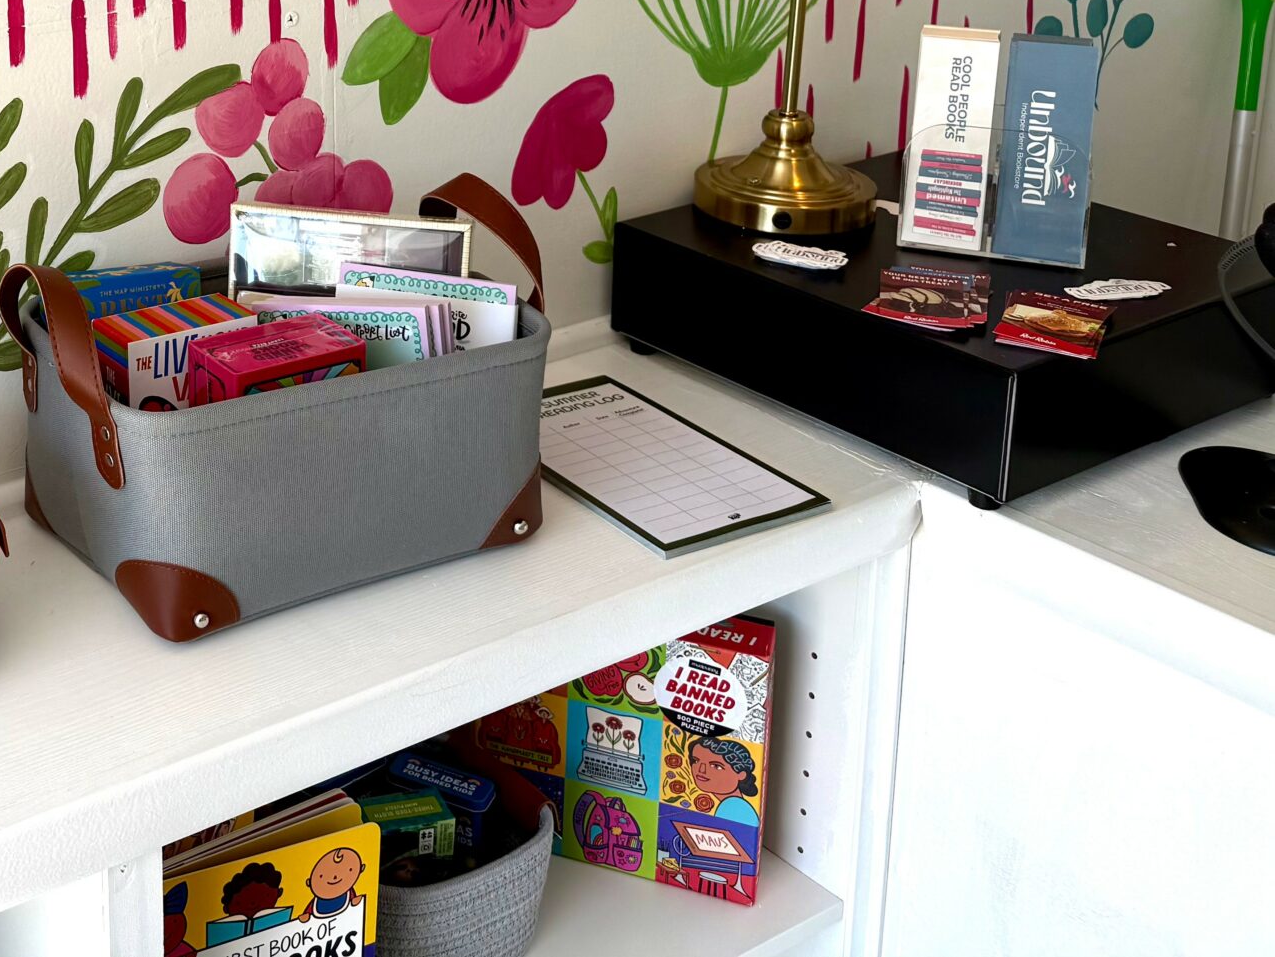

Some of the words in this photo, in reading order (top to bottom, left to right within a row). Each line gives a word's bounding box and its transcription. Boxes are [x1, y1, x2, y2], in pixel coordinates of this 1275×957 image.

[949, 57, 962, 92] READ
[960, 56, 972, 91] COOL
[944, 95, 958, 140] BOOKS
[955, 93, 969, 143] PEOPLE
[1021, 90, 1056, 205] Unbound
[1014, 152, 1023, 189] Bookstore
[926, 193, 967, 204] Untamed
[883, 270, 906, 278] YOUR
[1035, 291, 1058, 301] GET
[1073, 300, 1108, 310] FREE
[1035, 336, 1057, 346] Robin
[136, 356, 153, 372] THE
[540, 390, 601, 409] SUMMER
[597, 393, 625, 407] LOG
[749, 637, 757, 646] I
[587, 666, 616, 689] GIVING
[675, 667, 684, 679] I
[686, 670, 731, 693] READ
[665, 679, 735, 709] BANNED
[670, 696, 726, 723] BOOKS
[677, 714, 691, 723] 500
[693, 719, 715, 730] PIECE
[681, 722, 709, 735] PUZZLE
[403, 769, 420, 778] FOR
[422, 775, 450, 788] BORED
[452, 785, 474, 796] KIDS
[406, 763, 439, 779] BUSY
[441, 775, 478, 791] IDEAS
[695, 833, 729, 849] MAUS
[269, 927, 314, 954] BOOK
[317, 918, 337, 937] OF
